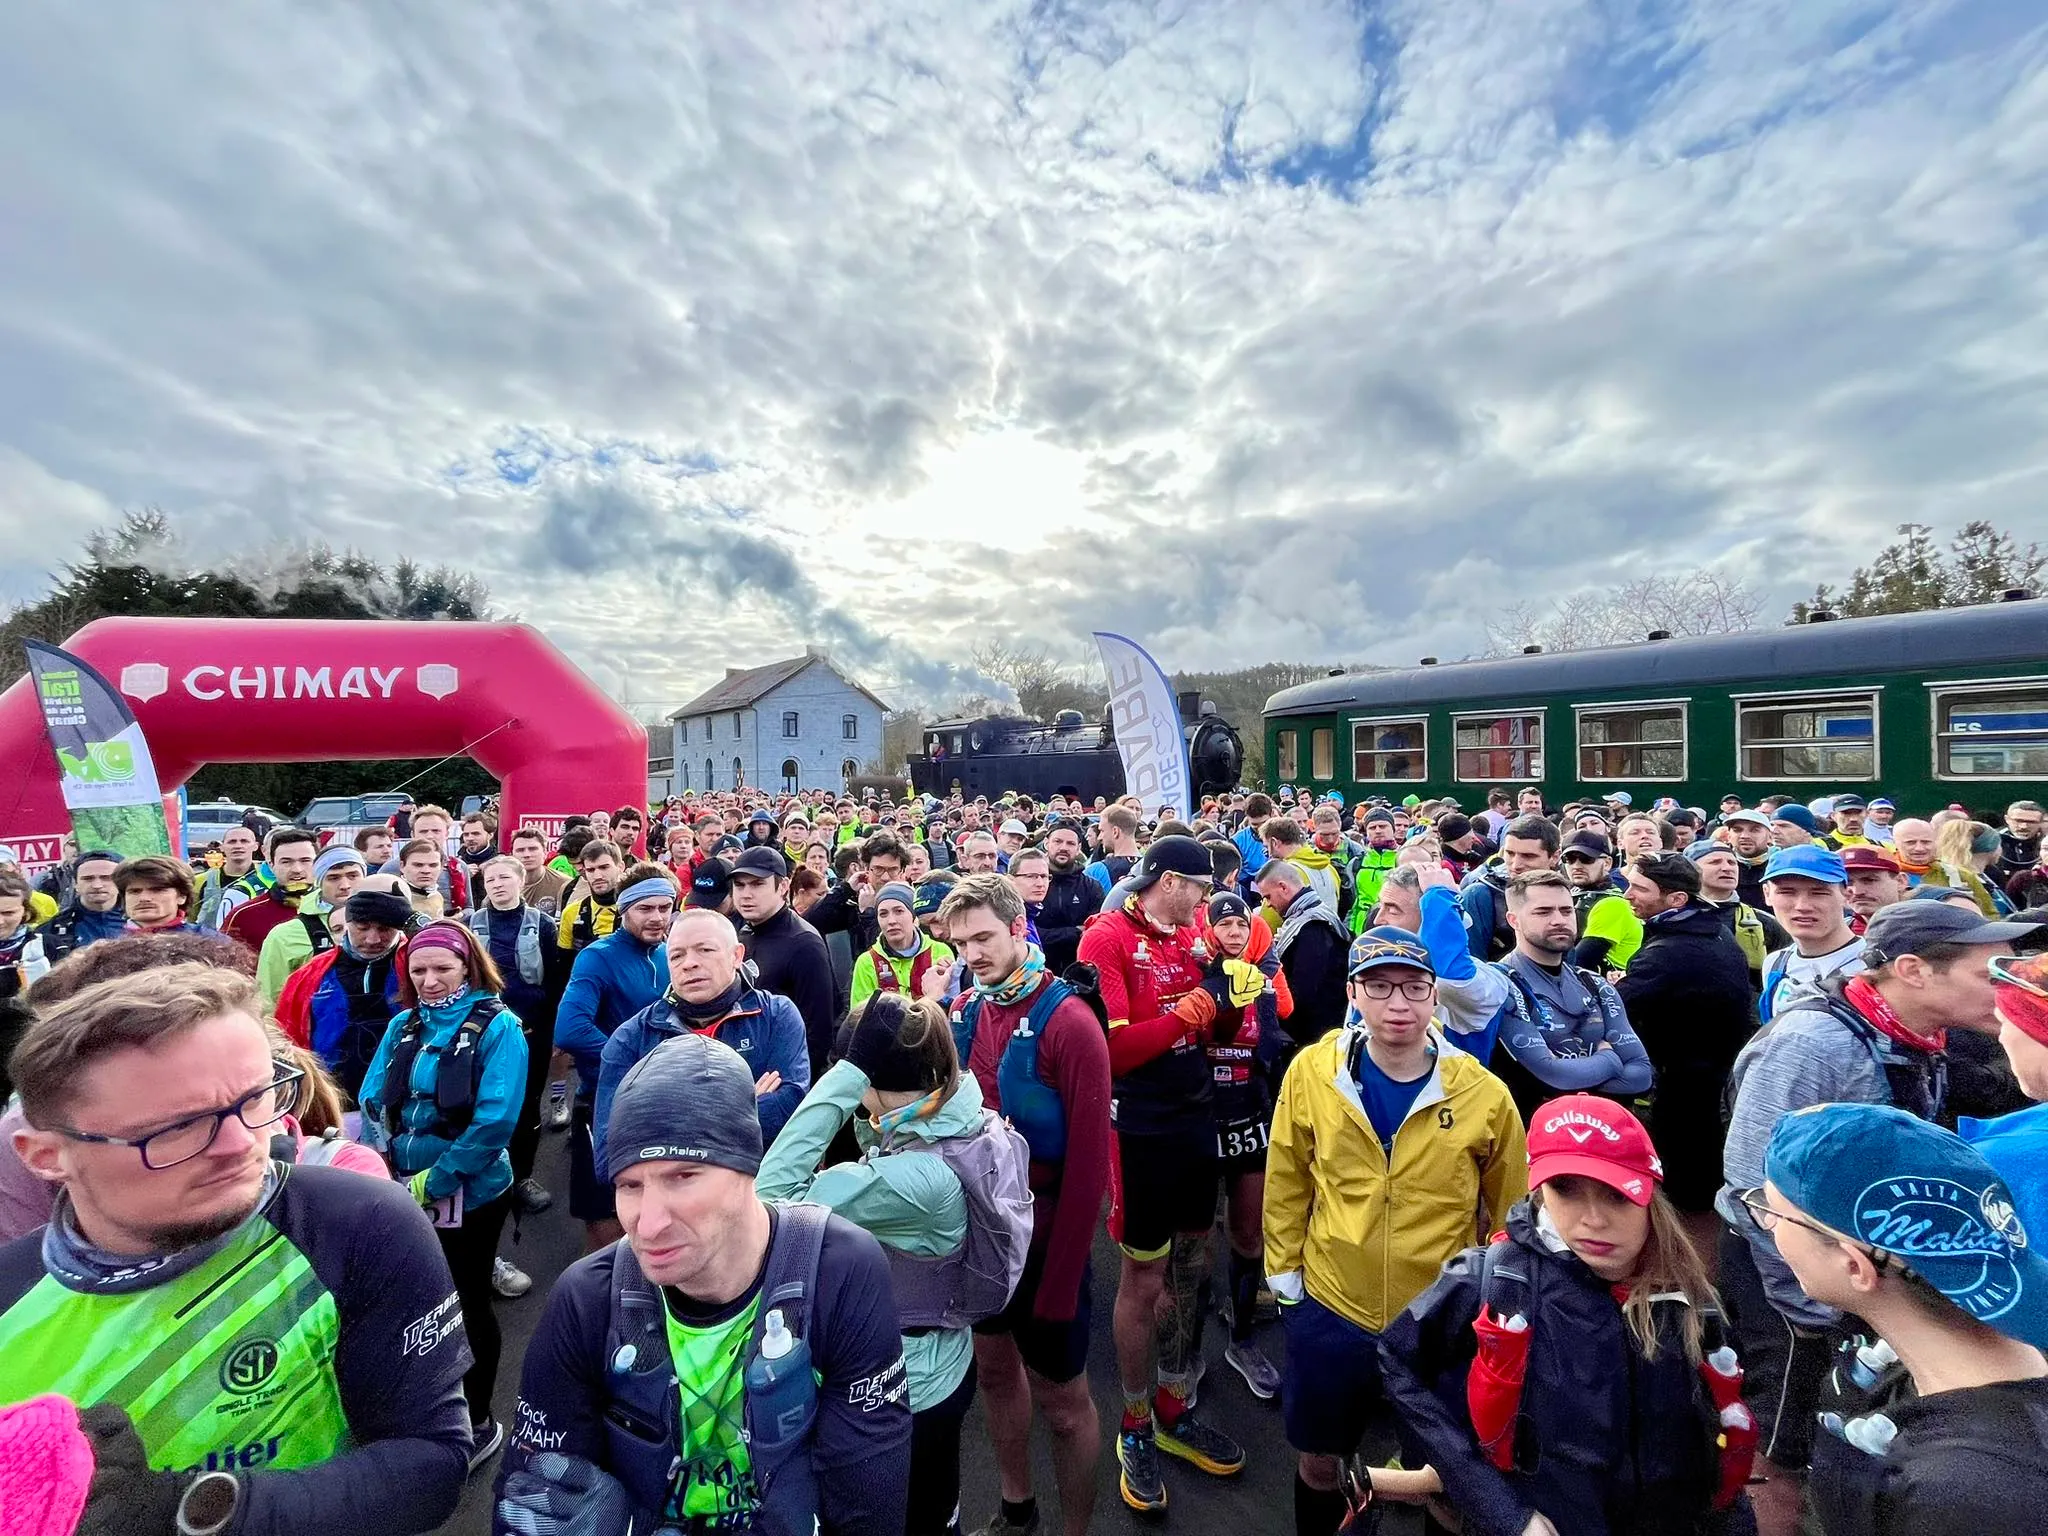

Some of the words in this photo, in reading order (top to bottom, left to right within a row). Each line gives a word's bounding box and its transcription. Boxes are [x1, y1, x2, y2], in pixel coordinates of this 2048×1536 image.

[182, 665, 404, 700] CHIMAY
[1950, 722, 1982, 733] ES
[1217, 1047, 1252, 1060] LEBRUN
[1544, 1110, 1621, 1141] Callaway
[1889, 1182, 1958, 1202] MALTA
[1862, 1209, 2006, 1252] Malta
[1951, 1282, 2011, 1313] INAL
